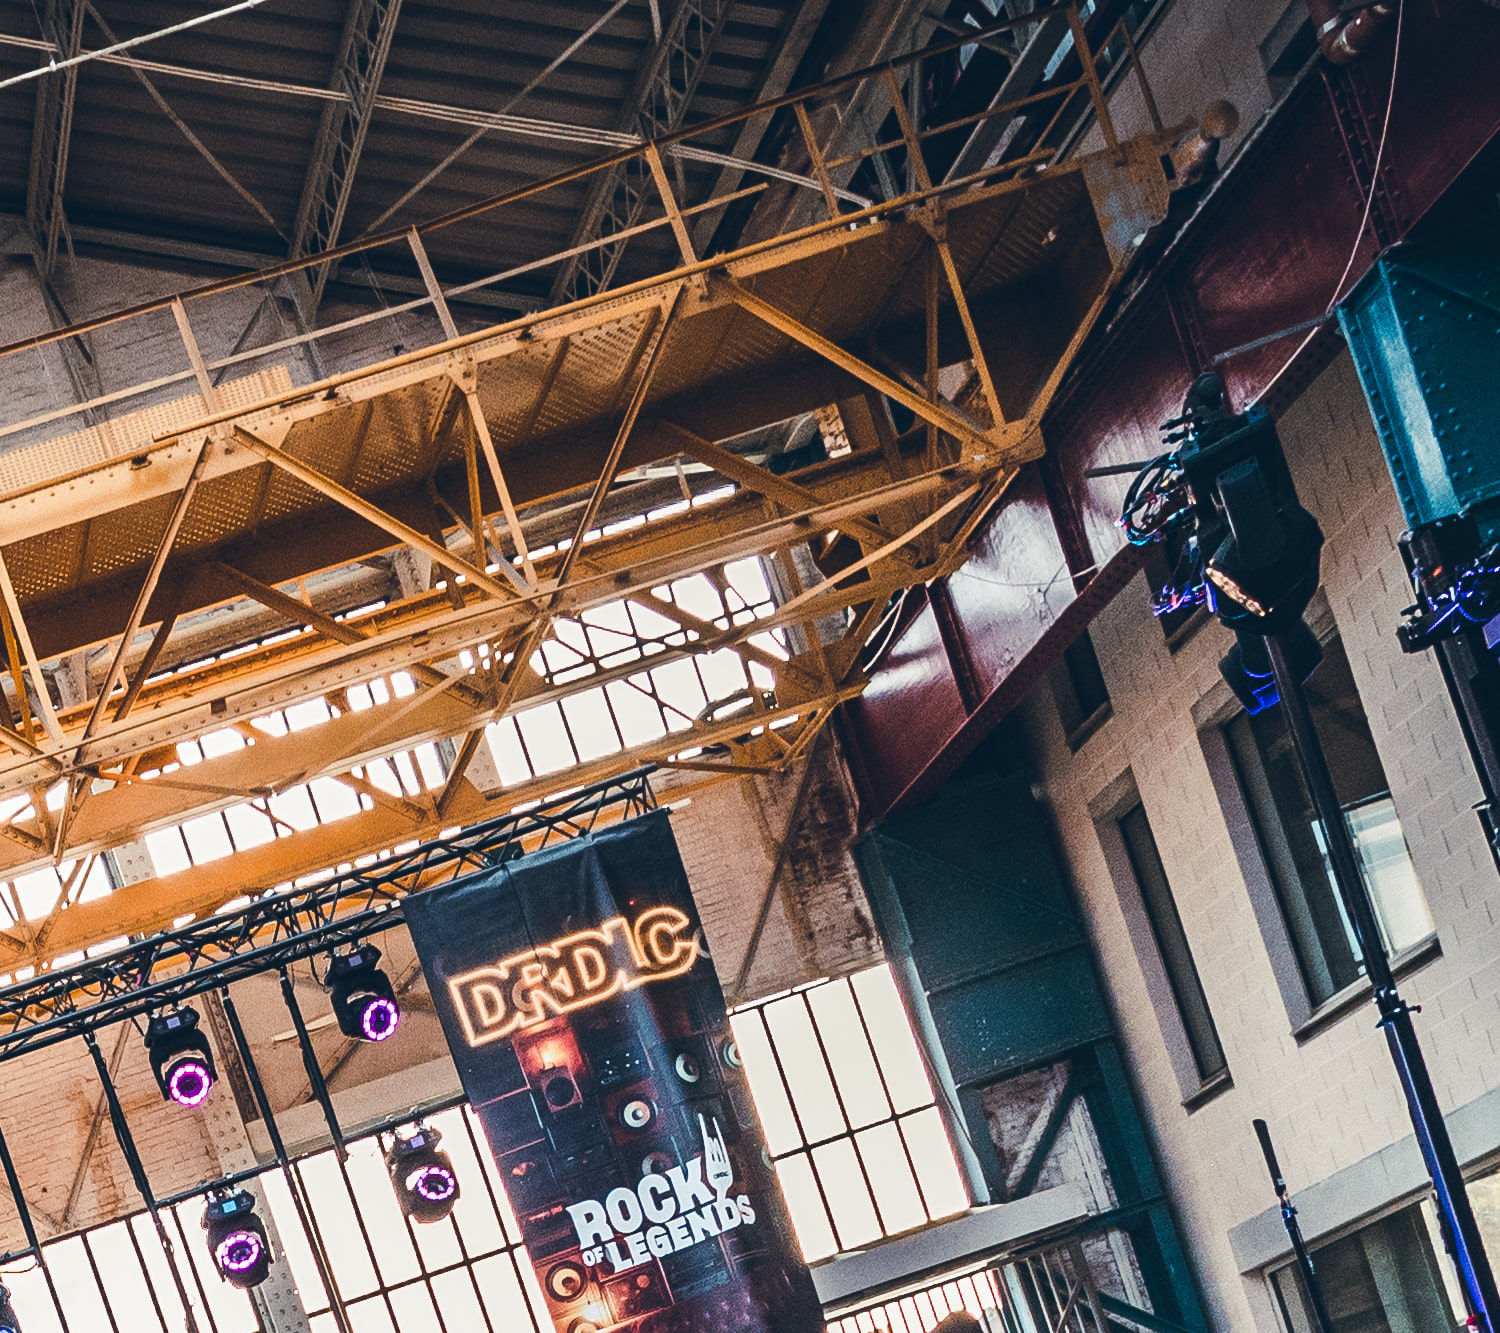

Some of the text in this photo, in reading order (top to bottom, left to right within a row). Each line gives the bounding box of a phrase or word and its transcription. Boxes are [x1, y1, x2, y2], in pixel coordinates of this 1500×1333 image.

[565, 1156, 716, 1250] ROCK
[582, 1194, 756, 1274] OF LEGENDS
